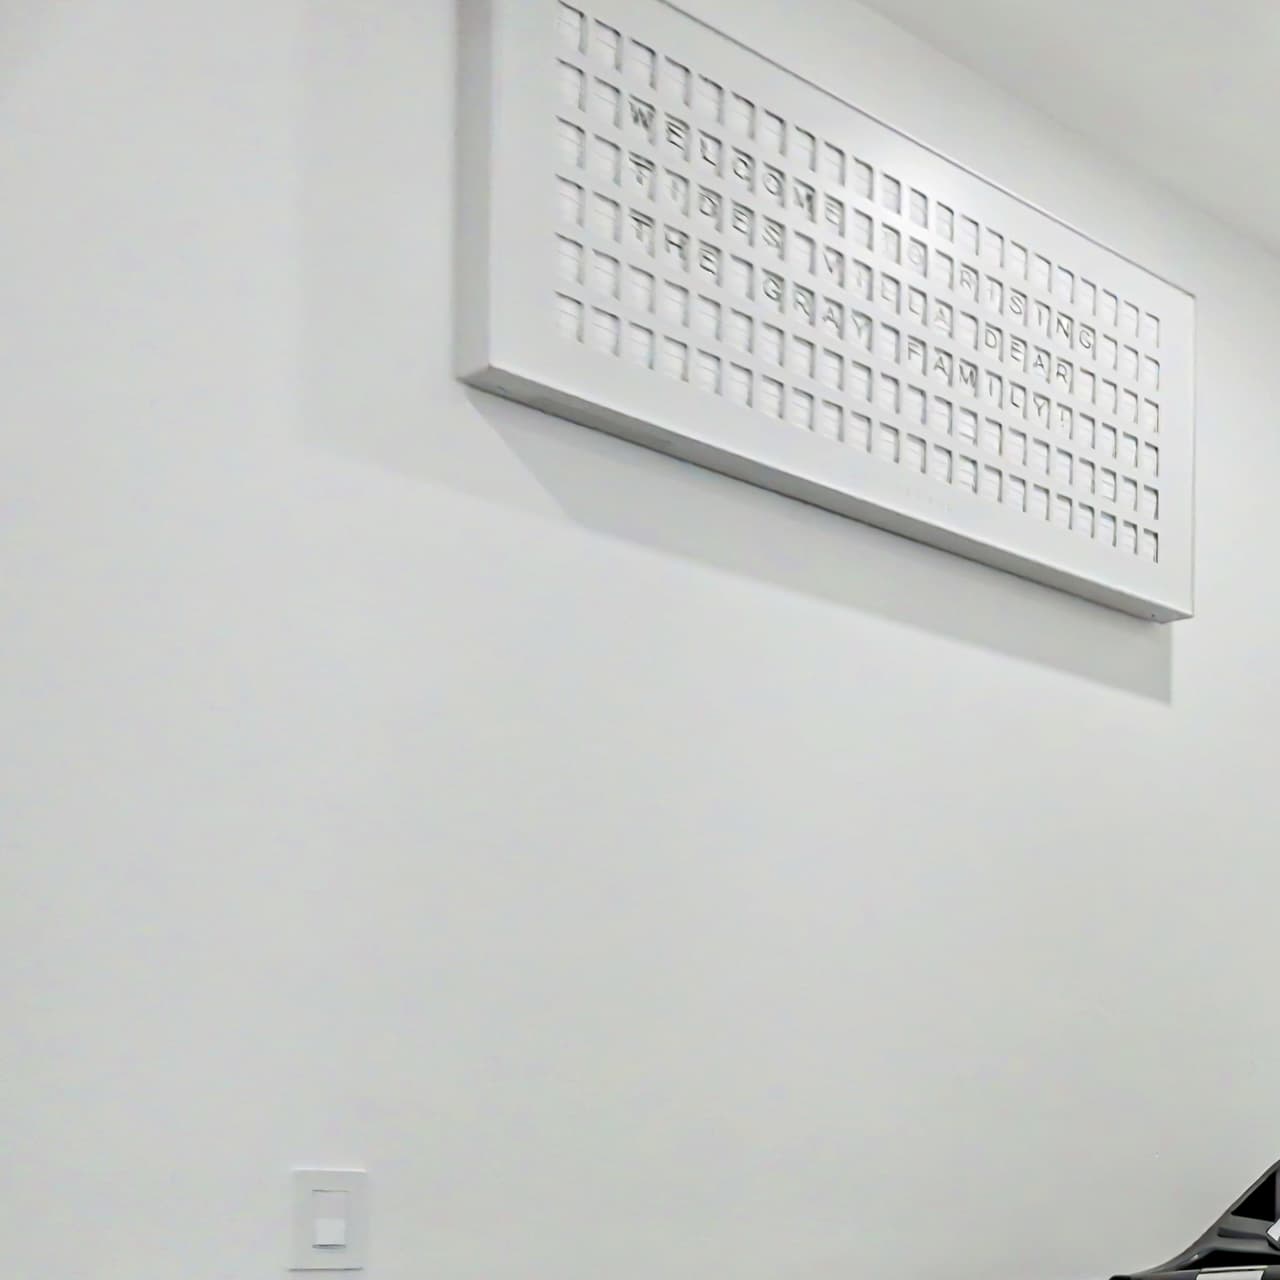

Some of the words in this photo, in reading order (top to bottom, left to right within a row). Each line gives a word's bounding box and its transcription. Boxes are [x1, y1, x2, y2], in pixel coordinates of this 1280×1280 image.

[628, 156, 782, 249] TIDES
[984, 328, 1068, 384] DEAR
[628, 212, 718, 276] THE
[762, 277, 872, 339] GRAY
[629, 100, 843, 226] WELCOME
[960, 268, 1092, 349] RISING
